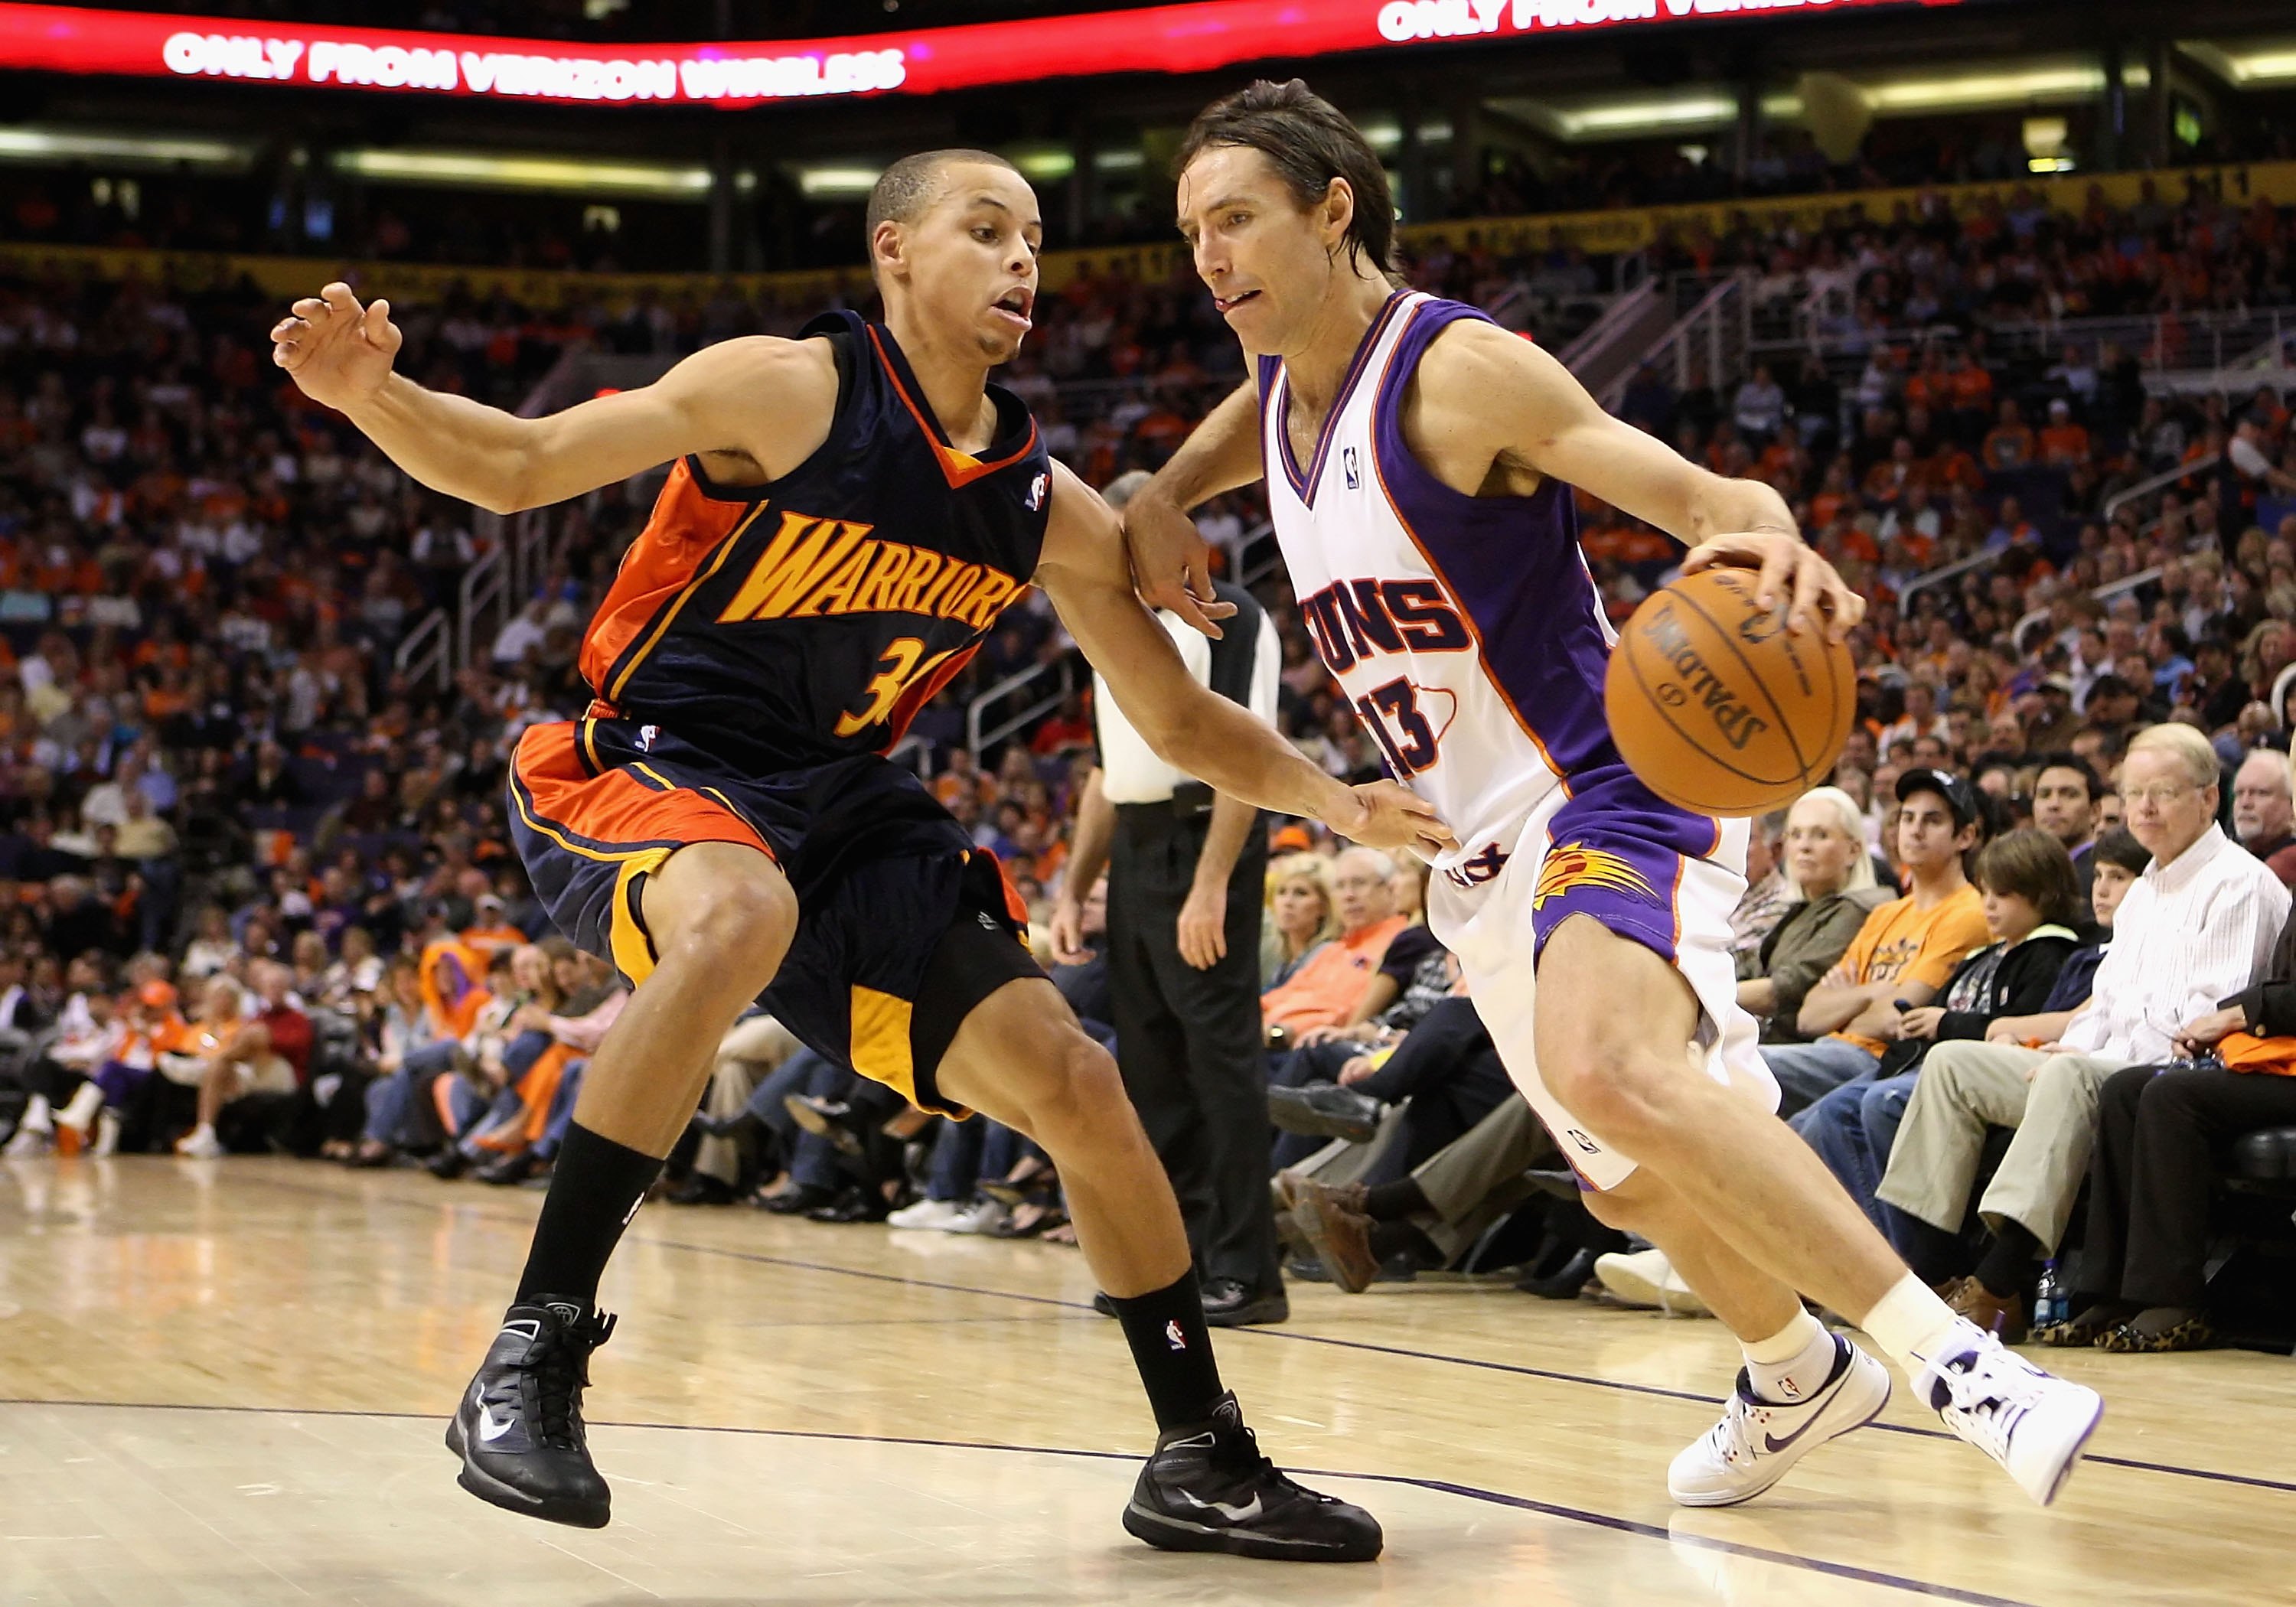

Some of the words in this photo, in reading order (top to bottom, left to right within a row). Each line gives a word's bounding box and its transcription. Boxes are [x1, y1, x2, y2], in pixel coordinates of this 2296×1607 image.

[163, 32, 304, 80] ONLY
[308, 41, 458, 90] FROM
[461, 51, 677, 99] VERIZON
[680, 49, 905, 99] WIRELESS
[1378, 0, 1502, 41] ONLY
[715, 510, 1018, 630] WARRIOR
[1299, 577, 1473, 675] UNS
[833, 636, 926, 737] 3
[1355, 674, 1439, 780] 13
